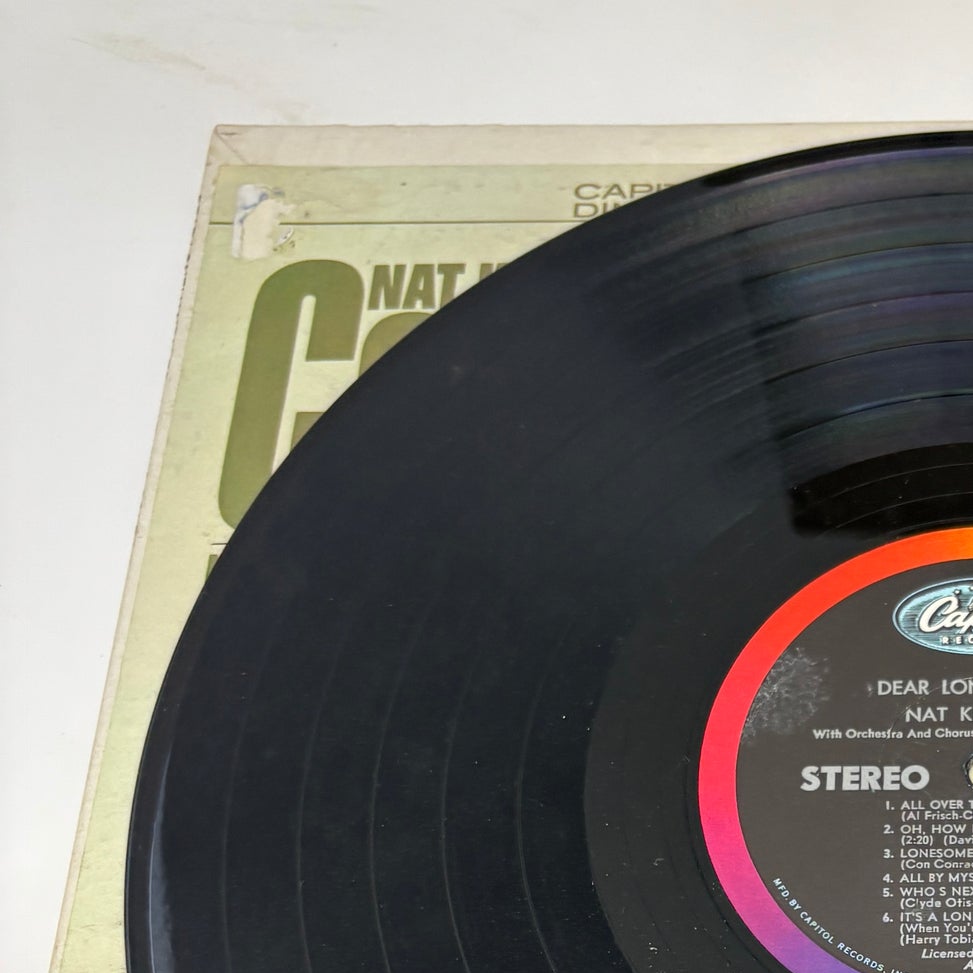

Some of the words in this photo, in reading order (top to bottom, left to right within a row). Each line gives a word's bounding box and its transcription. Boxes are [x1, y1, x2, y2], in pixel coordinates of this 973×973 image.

[574, 202, 621, 218] DI
[368, 263, 466, 310] NAT
[877, 680, 930, 696] DEAR
[905, 706, 948, 722] NAT
[813, 728, 842, 740] With
[845, 728, 903, 740] Orchestra
[907, 728, 931, 739] And
[800, 764, 930, 792] STEREO
[900, 800, 925, 810] ALL
[930, 800, 964, 810] OVER
[901, 811, 920, 822] (Al
[883, 824, 894, 834] 2.
[900, 824, 926, 835] OH,
[932, 824, 966, 834] HOW
[901, 835, 933, 846] (2:20)
[883, 848, 894, 858] 3.
[901, 859, 930, 870] (Con
[882, 873, 894, 883] 4.
[900, 873, 924, 883] ALL
[928, 872, 944, 882] BY
[882, 888, 893, 898] 5.
[788, 898, 802, 911] BY
[800, 911, 834, 944] CAPITOL
[882, 912, 893, 922] 6.
[900, 912, 922, 922] IT'S
[928, 912, 938, 922] A
[900, 923, 940, 935] (When
[900, 934, 940, 946] (Harry
